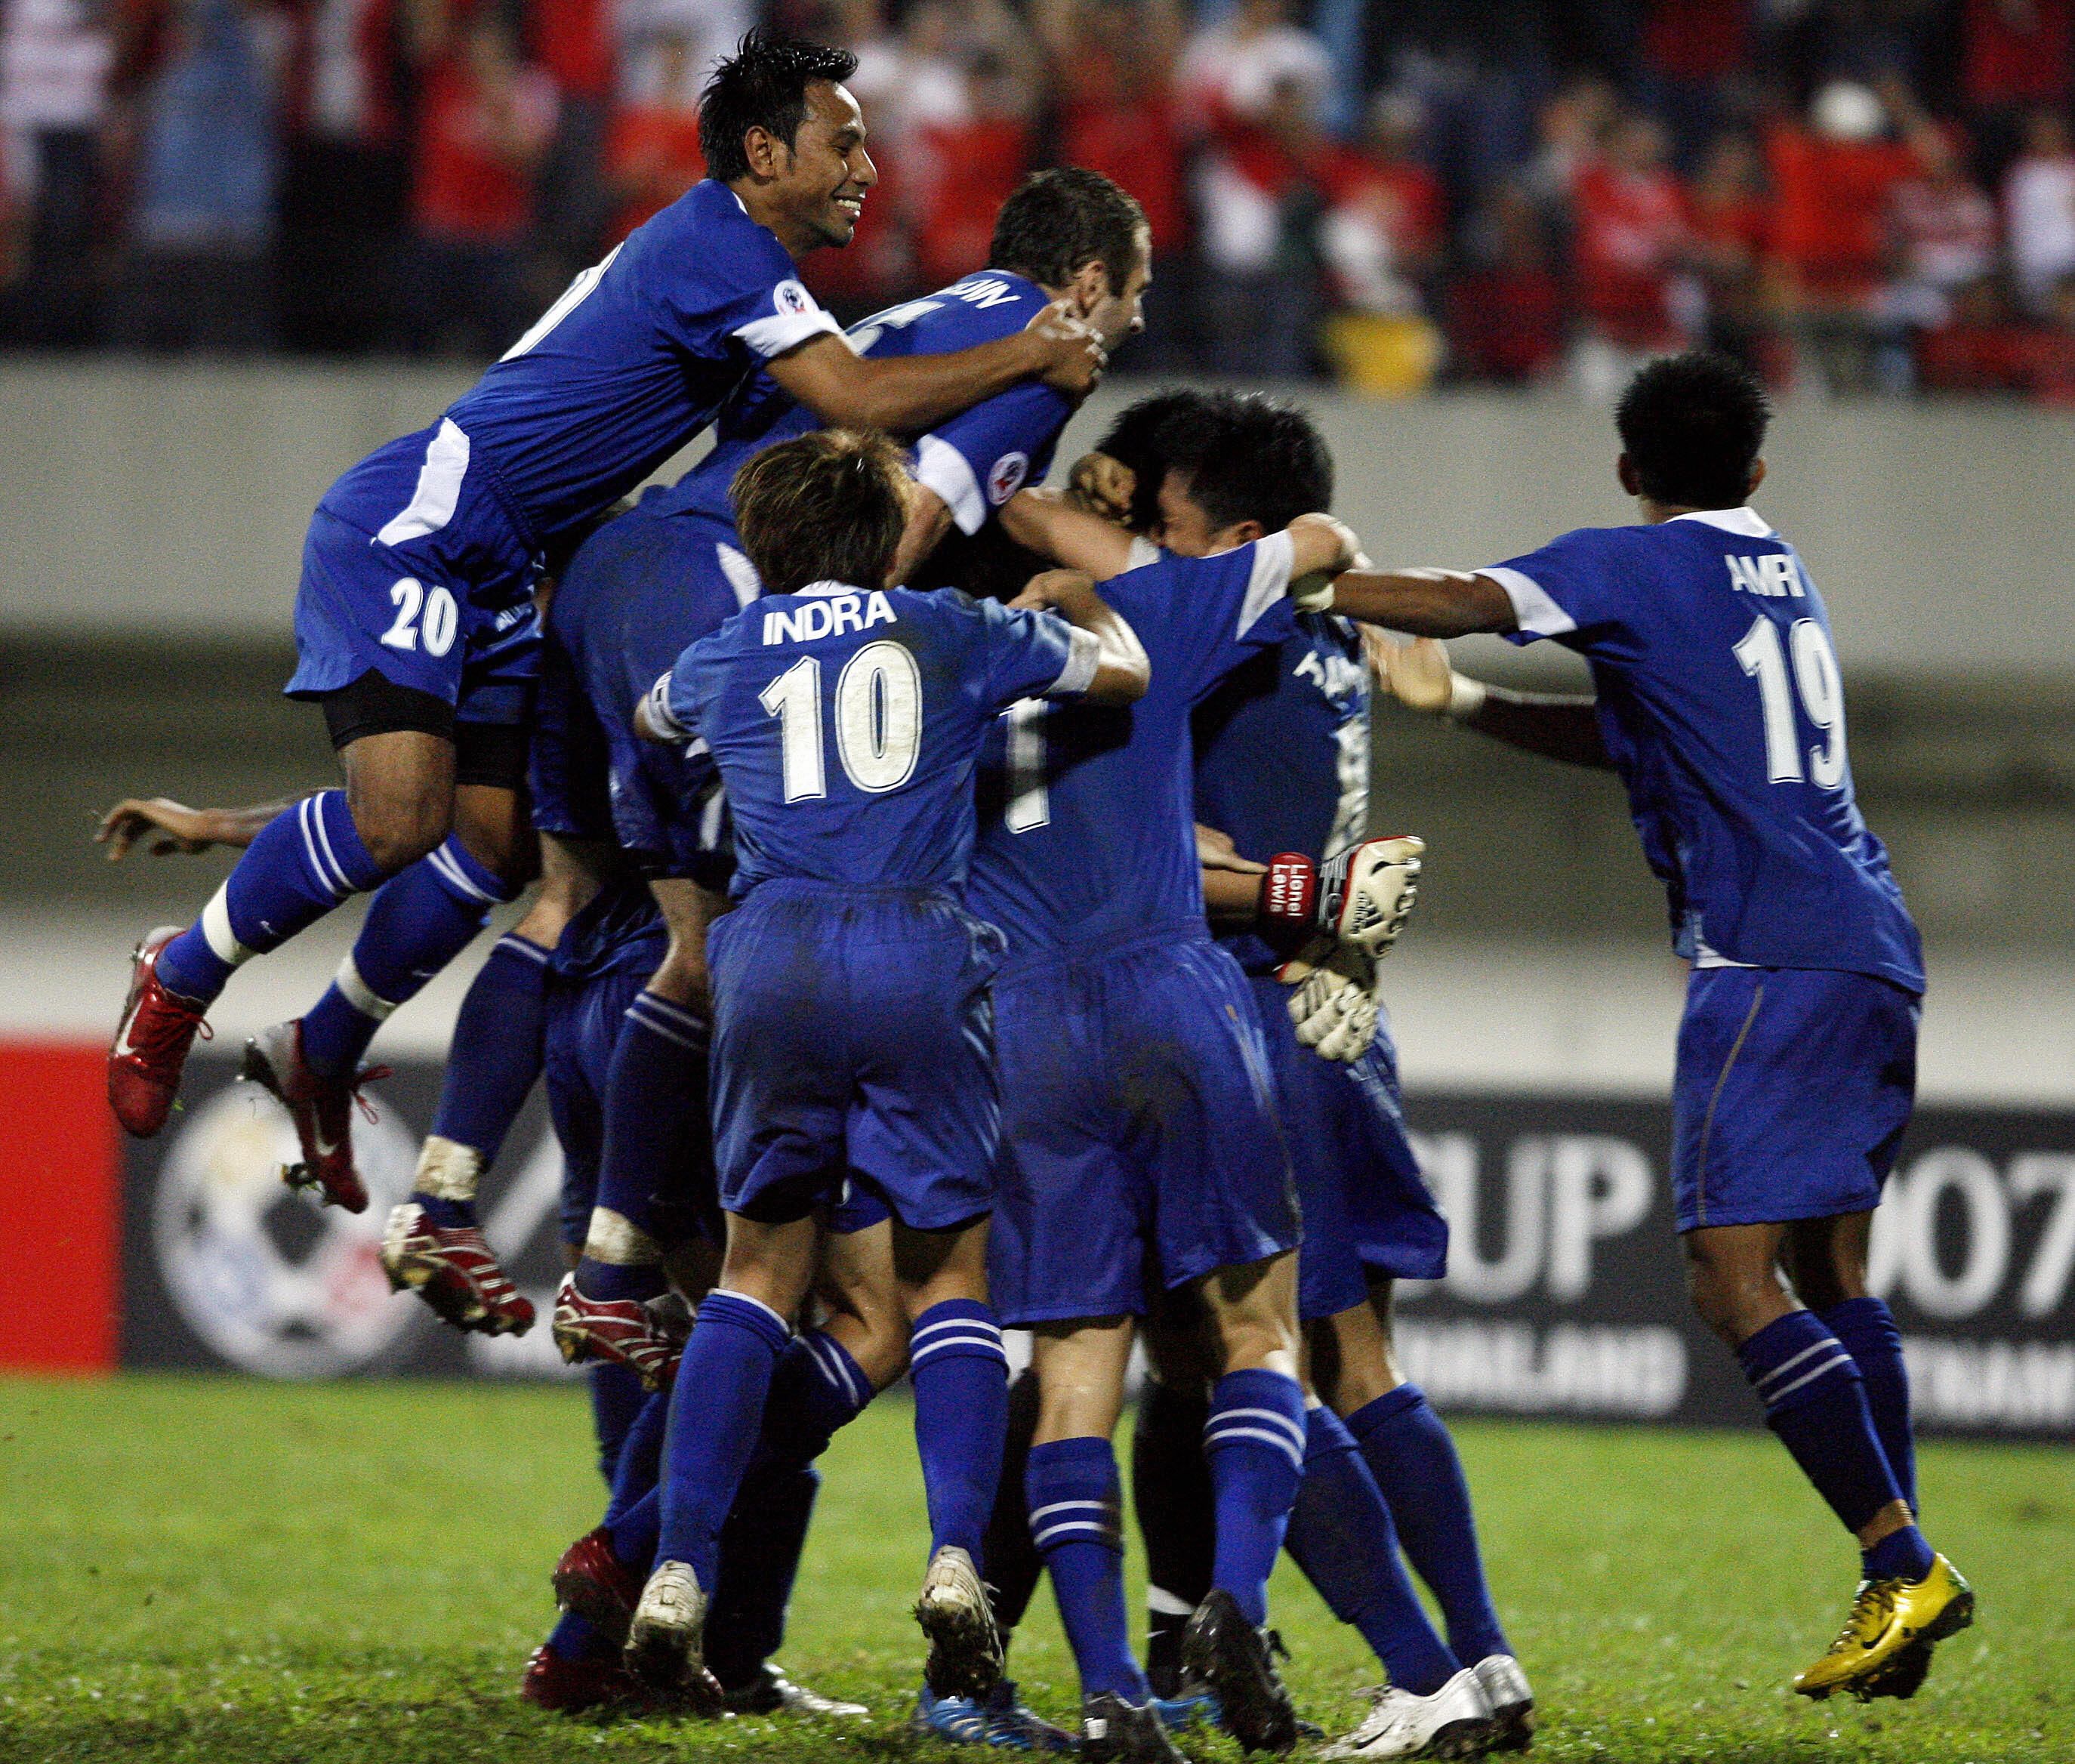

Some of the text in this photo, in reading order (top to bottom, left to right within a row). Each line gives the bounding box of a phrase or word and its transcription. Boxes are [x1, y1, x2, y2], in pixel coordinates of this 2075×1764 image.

[381, 576, 459, 658] 20
[763, 591, 898, 646] INDRA
[758, 640, 923, 804] 10
[1731, 614, 1848, 790] 19
[1286, 864, 1309, 917] Lionel
